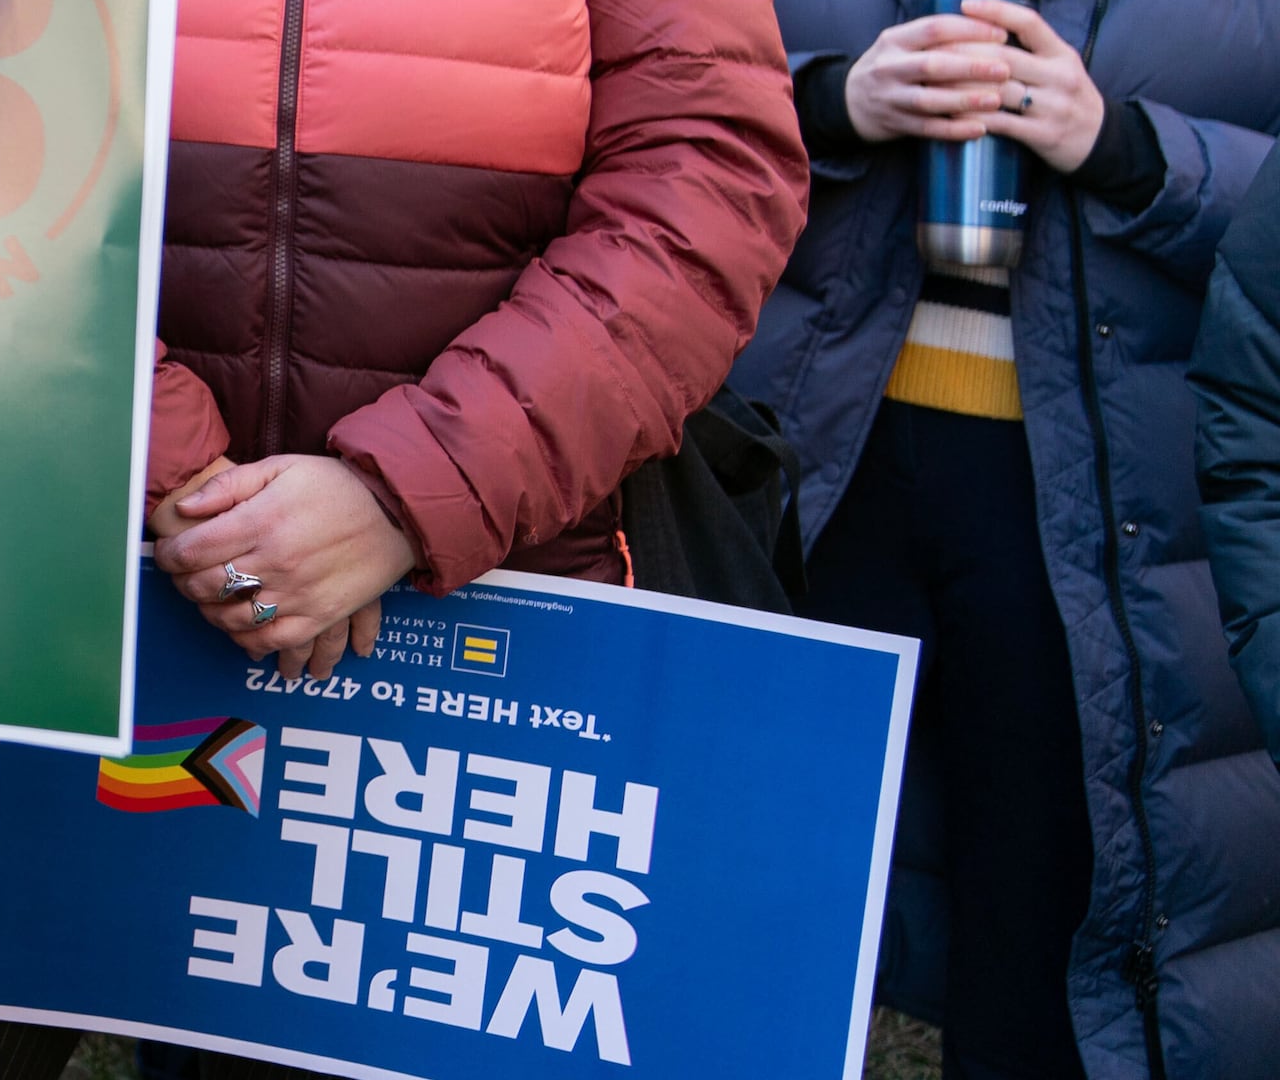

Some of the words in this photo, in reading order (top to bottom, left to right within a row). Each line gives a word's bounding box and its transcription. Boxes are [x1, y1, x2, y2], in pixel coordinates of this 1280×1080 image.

[380, 615, 447, 631] CAMPAI
[372, 647, 443, 668] HUMA
[371, 680, 405, 707] to
[416, 686, 519, 725] HERE
[278, 727, 659, 875] HERE
[280, 818, 651, 966] STILL
[187, 896, 632, 1067] WE'RE
